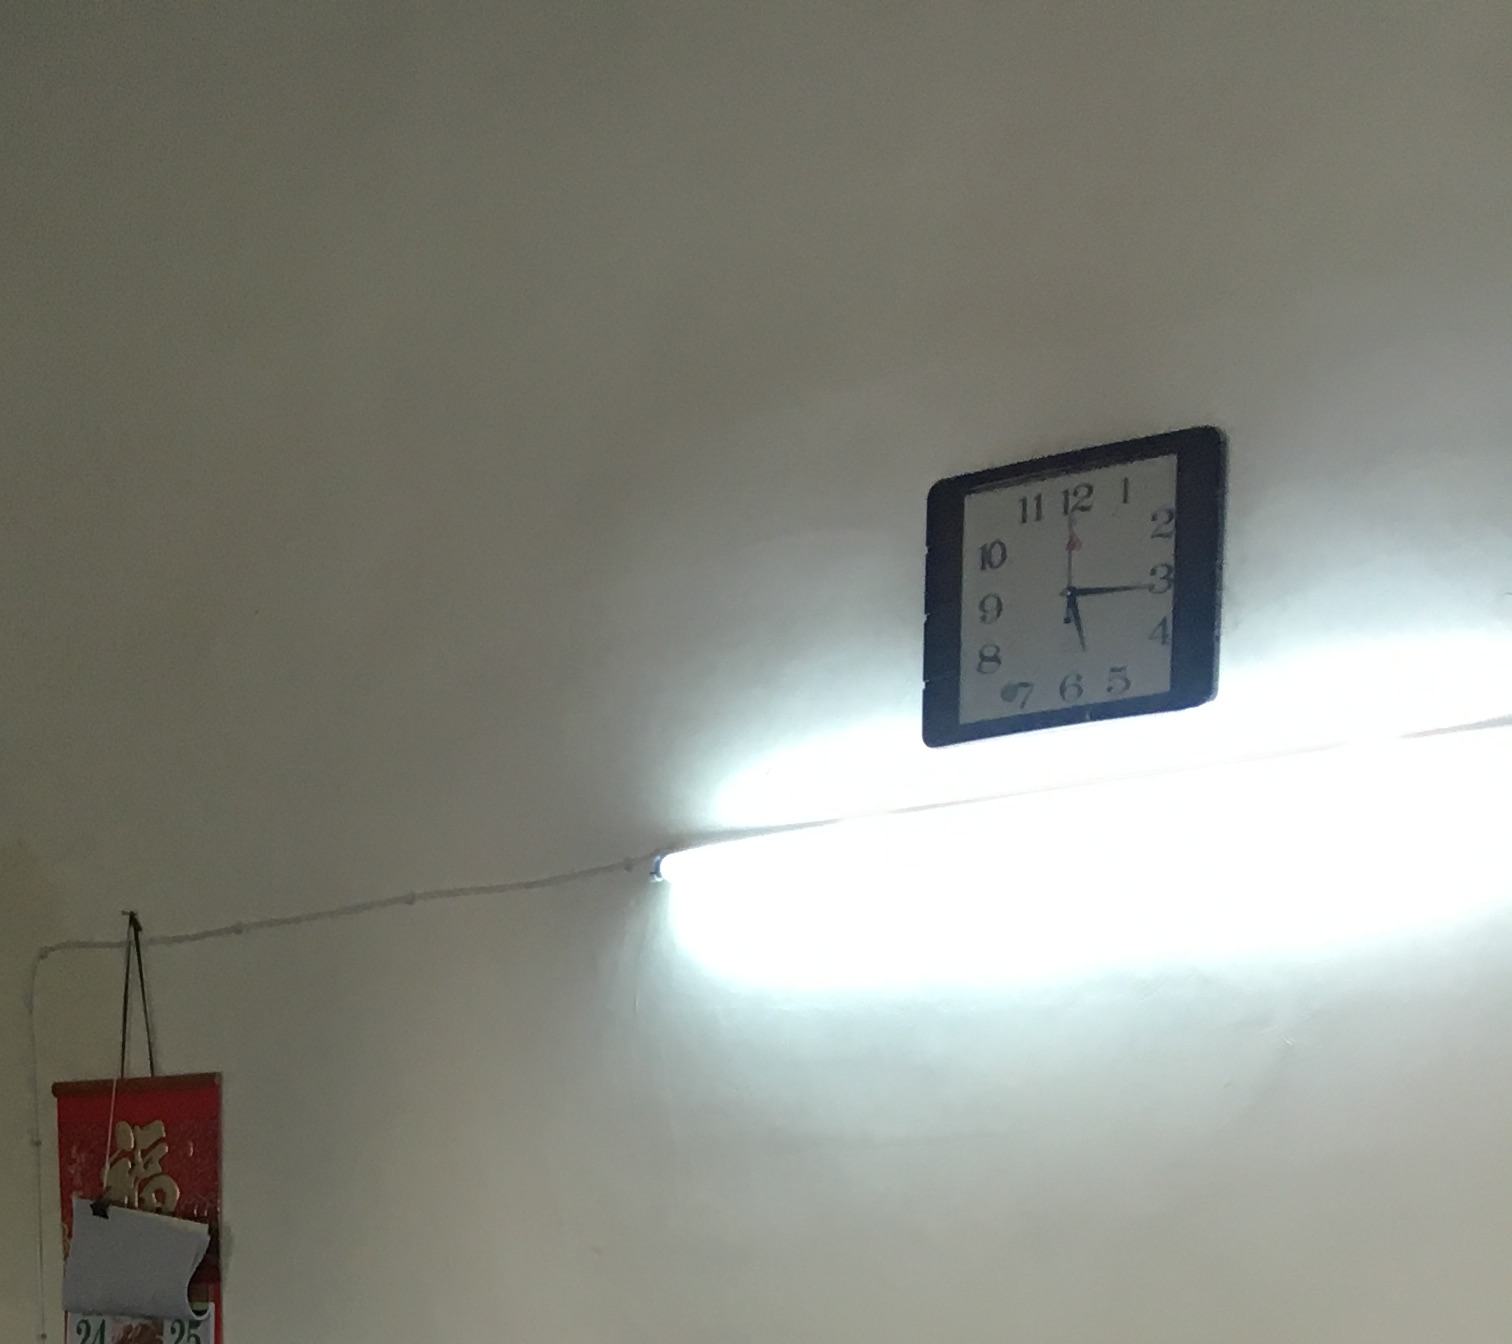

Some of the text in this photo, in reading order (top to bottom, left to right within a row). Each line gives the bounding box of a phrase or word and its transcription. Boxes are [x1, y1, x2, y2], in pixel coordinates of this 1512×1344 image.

[1061, 482, 1094, 516] 12
[1120, 476, 1129, 504] 1
[1019, 493, 1043, 524] 11
[1150, 508, 1175, 540] 2
[978, 538, 1007, 571] 10
[1149, 563, 1174, 595] 3
[978, 593, 1003, 624] 9
[1148, 616, 1170, 646] 4
[977, 643, 1002, 675] 8
[1010, 681, 1034, 709] 7
[1059, 673, 1084, 702] 6
[1106, 666, 1132, 694] 5
